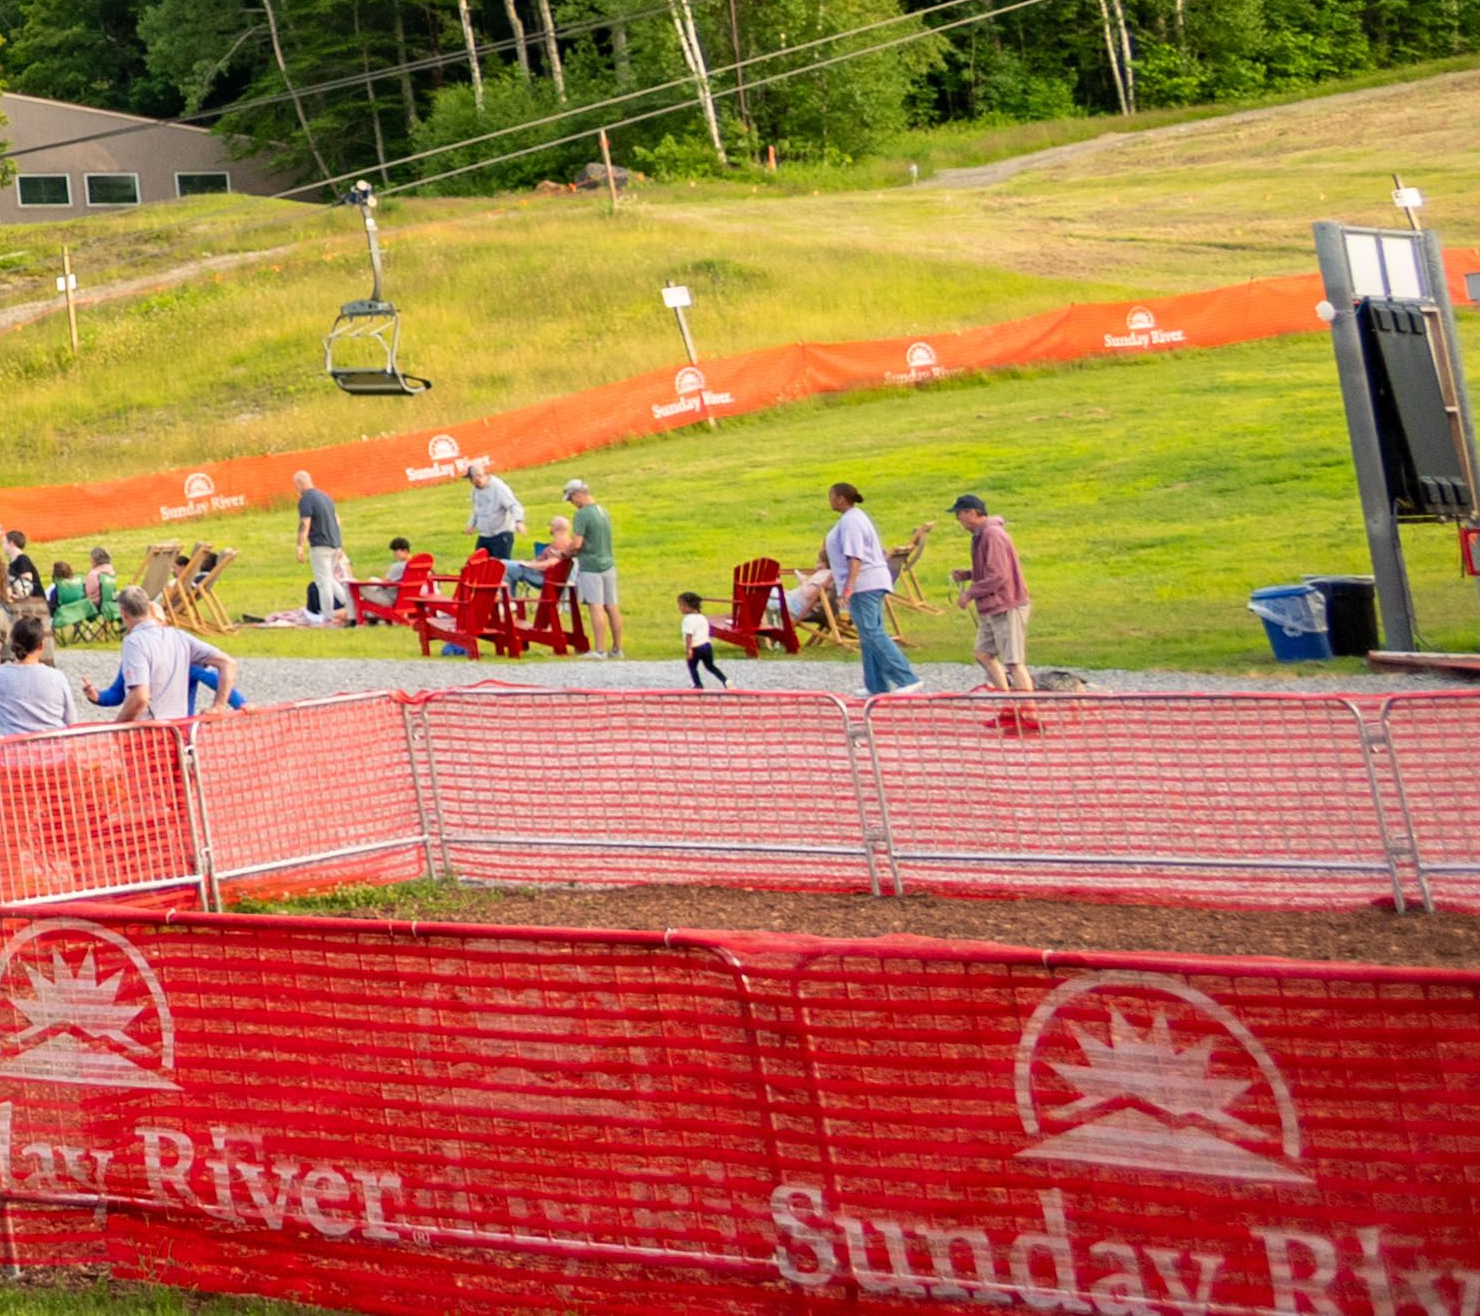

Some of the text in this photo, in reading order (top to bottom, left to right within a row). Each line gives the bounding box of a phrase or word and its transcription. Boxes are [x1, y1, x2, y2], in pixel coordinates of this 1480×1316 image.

[1104, 331, 1149, 349] Sunday
[651, 396, 700, 419] Sunday
[406, 461, 455, 481] Sunday
[160, 499, 209, 521] Sunday
[134, 1126, 402, 1240] River
[769, 1184, 1226, 1316] Sunday
[1251, 1225, 1480, 1316] Riv
